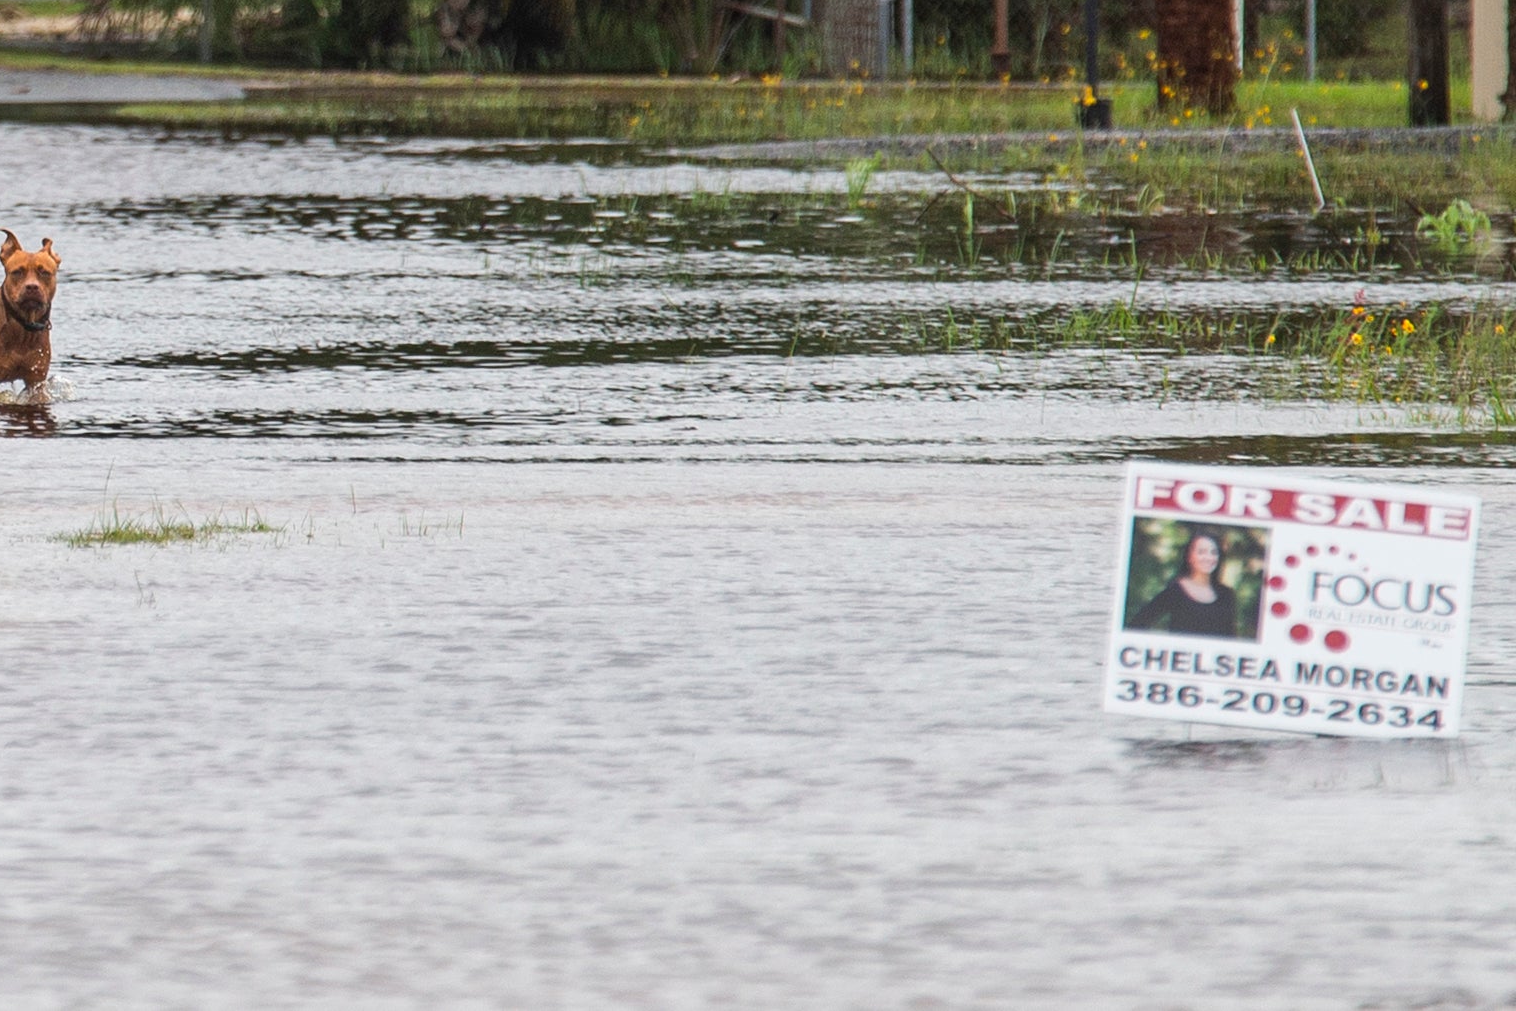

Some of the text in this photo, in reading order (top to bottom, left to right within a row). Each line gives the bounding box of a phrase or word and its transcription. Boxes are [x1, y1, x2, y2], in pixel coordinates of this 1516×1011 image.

[1137, 478, 1471, 539] FOR SALE
[1311, 571, 1458, 617] FOCUS
[1308, 608, 1343, 622] REAL
[1402, 619, 1456, 633] GROUP
[1119, 646, 1449, 699] CHELSEA MORGAN
[1116, 679, 1446, 731] 386-209-2634
